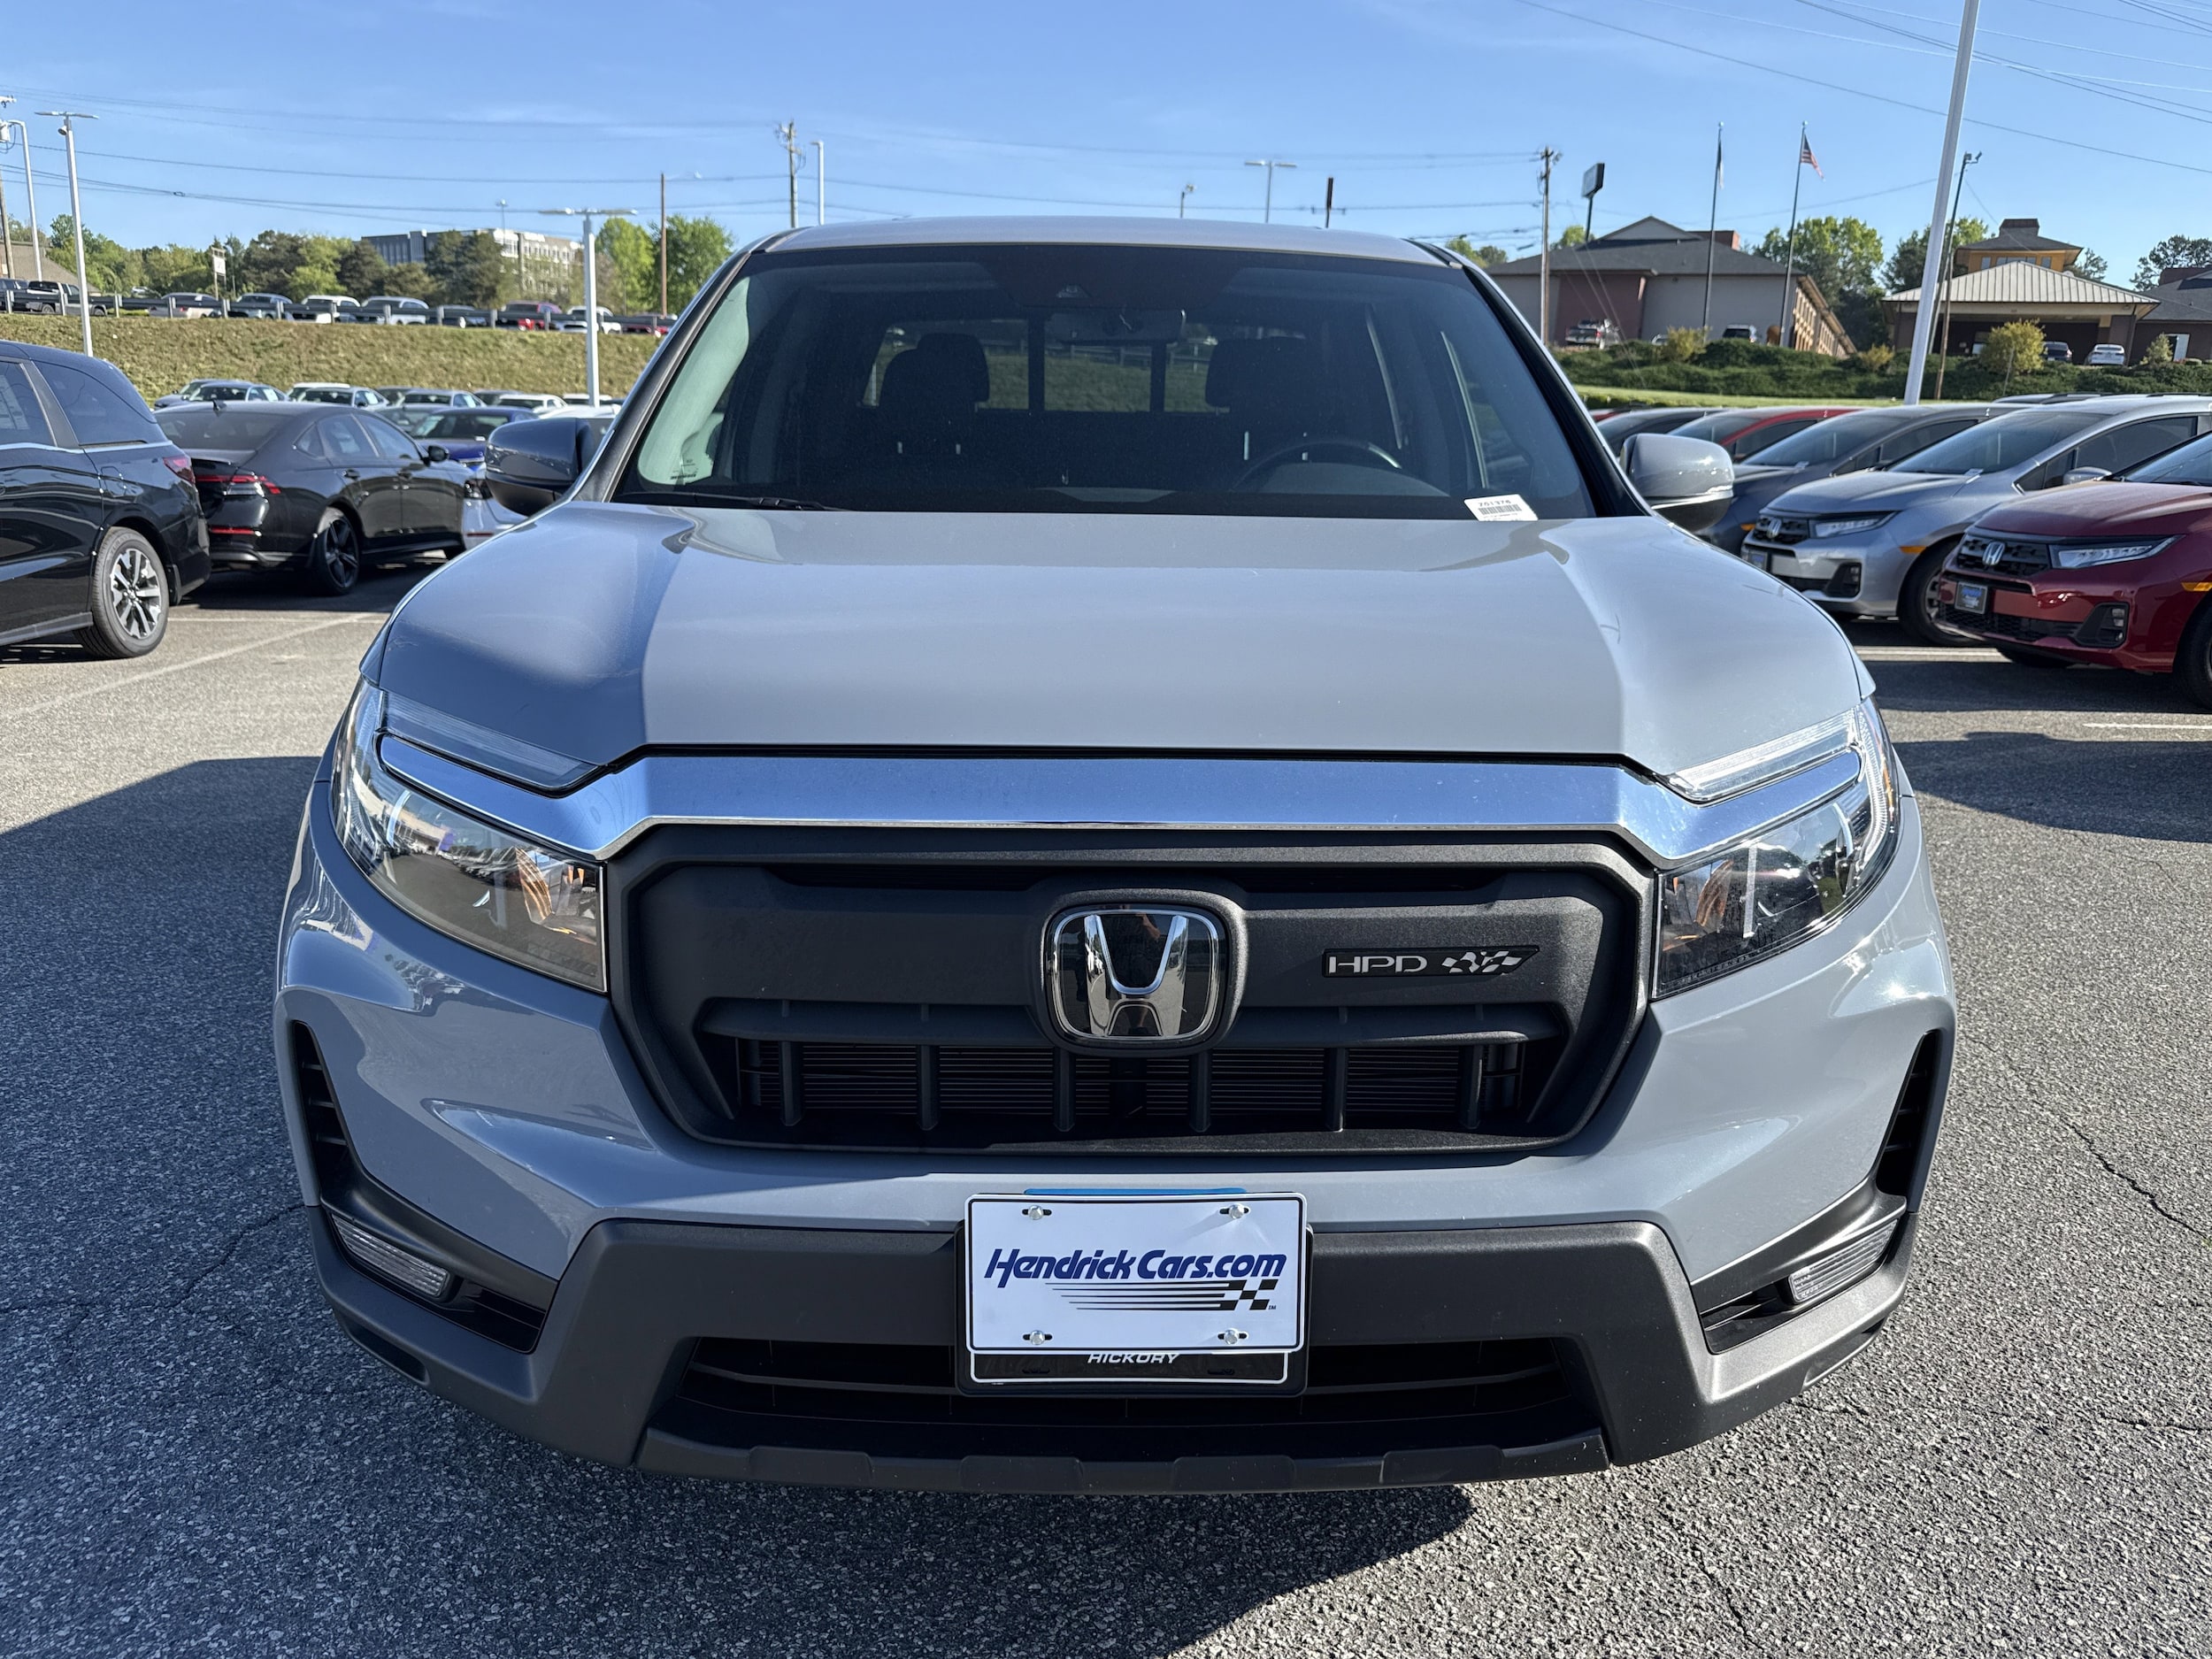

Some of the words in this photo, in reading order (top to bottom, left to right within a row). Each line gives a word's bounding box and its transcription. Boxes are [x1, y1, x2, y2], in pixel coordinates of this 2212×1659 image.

[1329, 955, 1428, 973] HPD
[984, 1248, 1137, 1288] Hendrick
[1137, 1249, 1287, 1279] Cars.com
[1087, 1353, 1180, 1363] HICKORY
